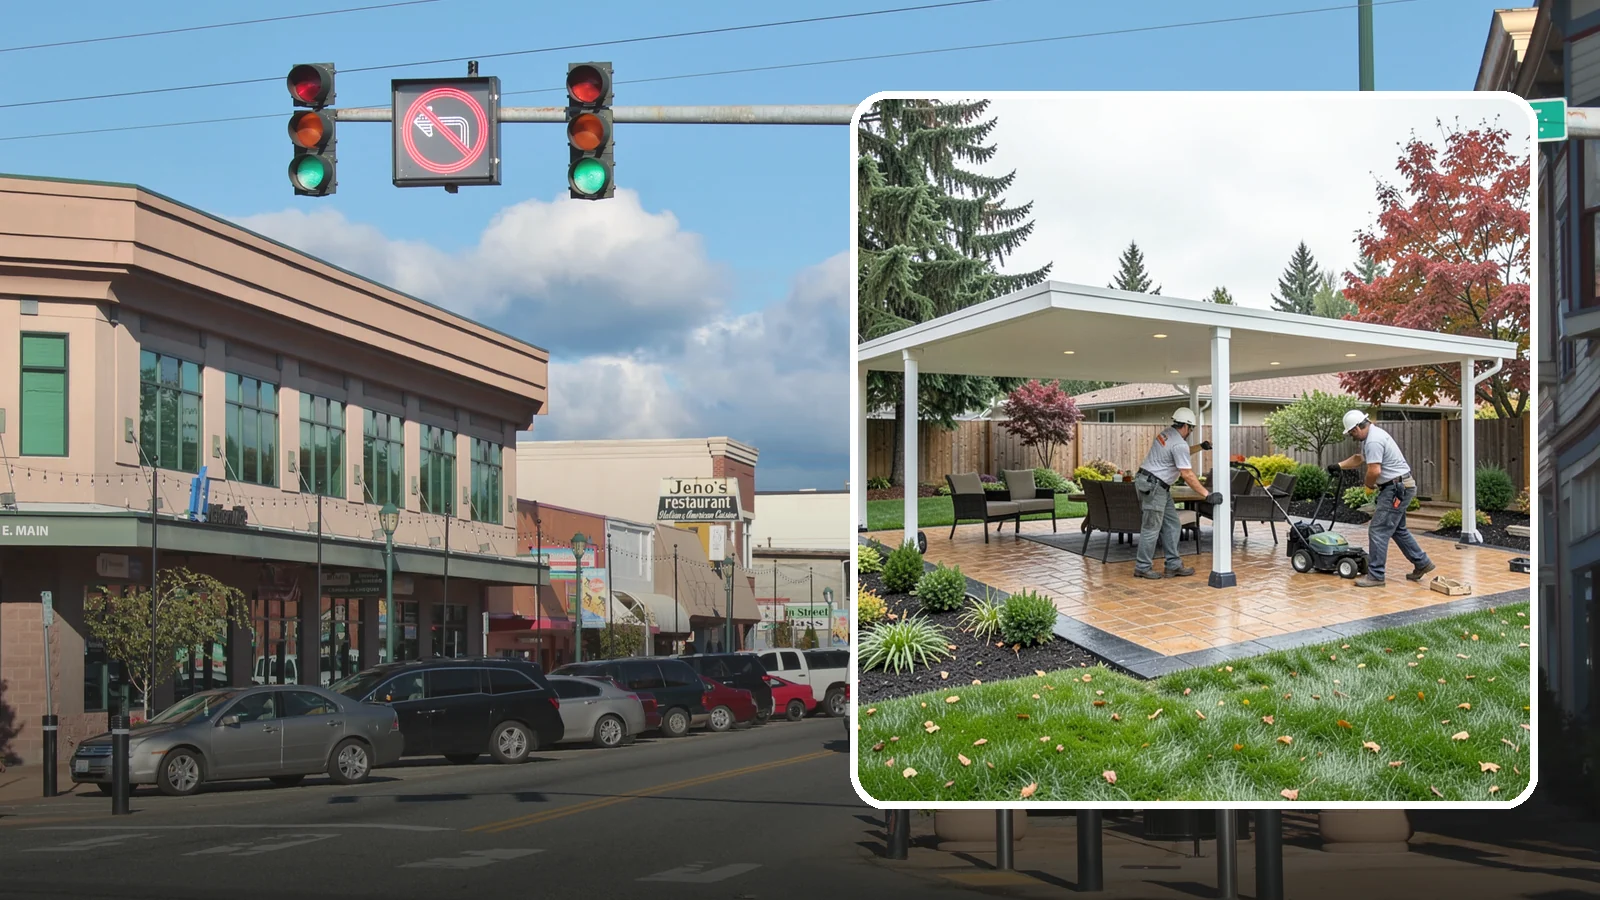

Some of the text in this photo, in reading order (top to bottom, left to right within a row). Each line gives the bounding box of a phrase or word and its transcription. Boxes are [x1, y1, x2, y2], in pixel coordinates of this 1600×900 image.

[669, 480, 728, 494] Jeno's
[665, 496, 731, 509] restaurant
[686, 509, 714, 519] American
[715, 509, 737, 519] Cuisine
[2, 525, 49, 536] E. MAIN
[797, 607, 828, 617] Street
[791, 619, 823, 627] lass
